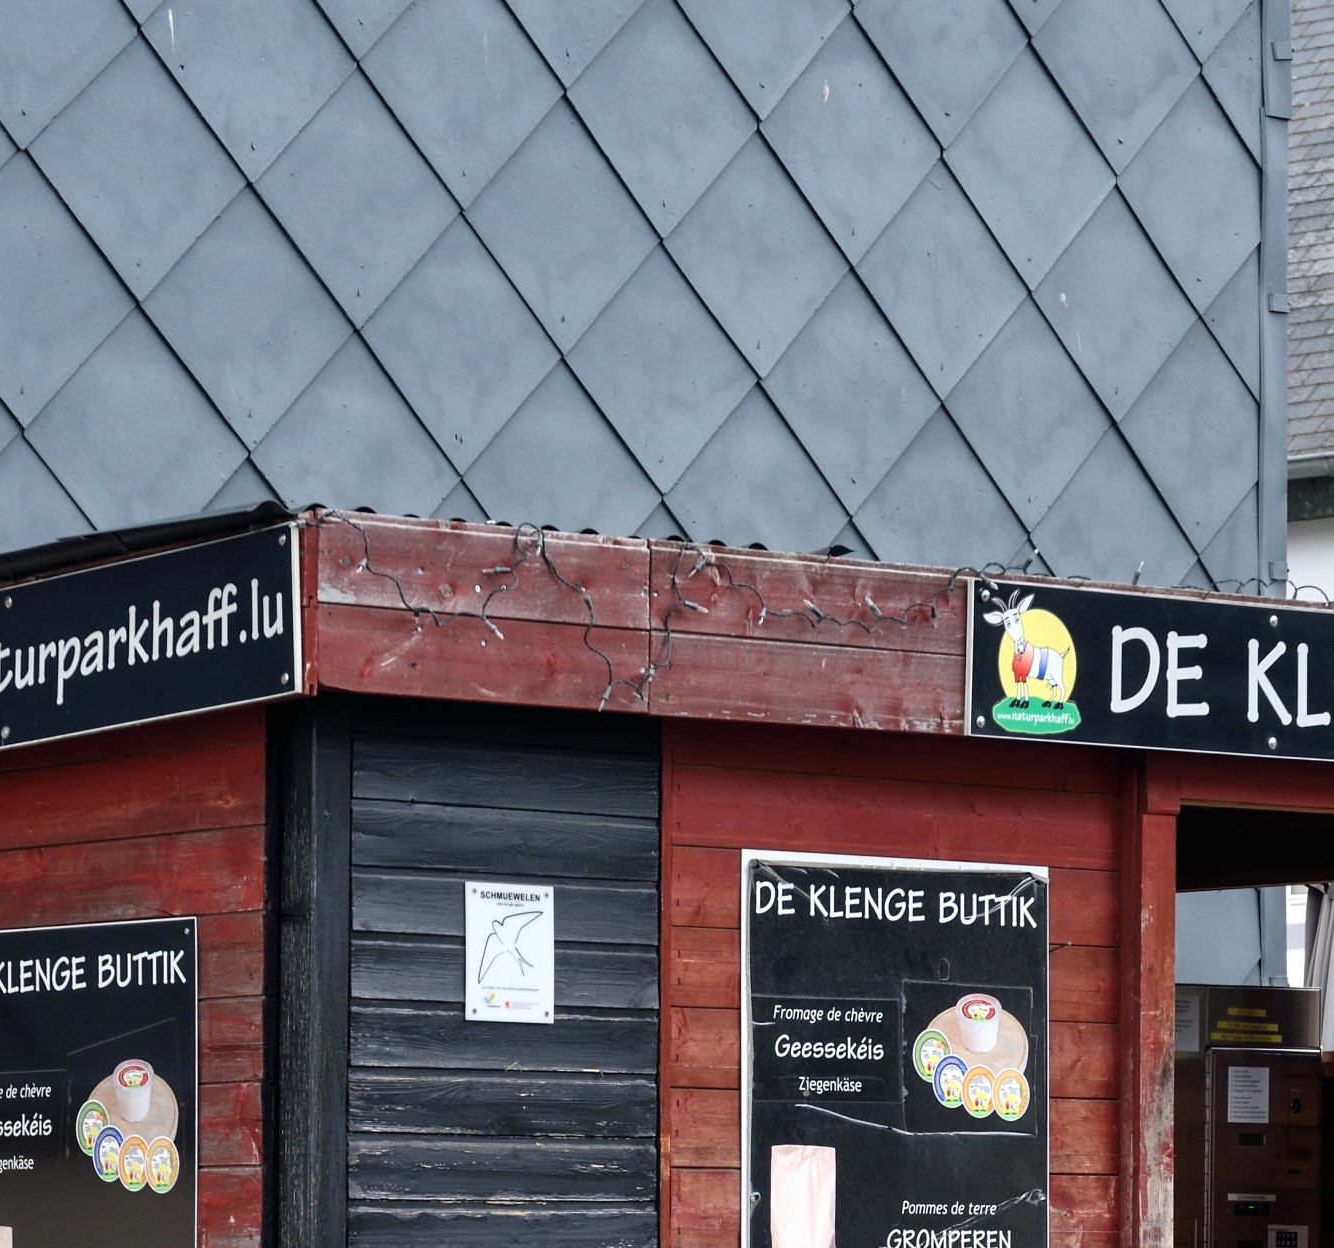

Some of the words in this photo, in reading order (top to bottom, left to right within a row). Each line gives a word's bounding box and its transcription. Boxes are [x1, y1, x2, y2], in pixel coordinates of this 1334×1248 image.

[1111, 626, 1209, 717] DE
[480, 890, 541, 902] SCHMUEWELEN
[756, 880, 795, 915] DE
[809, 884, 925, 922] KLENGE
[939, 890, 1037, 928] BUTTIK
[98, 949, 187, 989] BUTTIK
[773, 1005, 823, 1025] Fromage
[827, 1007, 842, 1022] de
[845, 1008, 884, 1023] chèvre
[774, 1034, 885, 1061] Geessekéis
[6, 1084, 18, 1099] de
[20, 1083, 52, 1099] chèvre
[799, 1077, 863, 1094] Ziegenkäse
[901, 1200, 947, 1215] Pommes
[950, 1201, 966, 1216] de
[969, 1202, 997, 1216] terre
